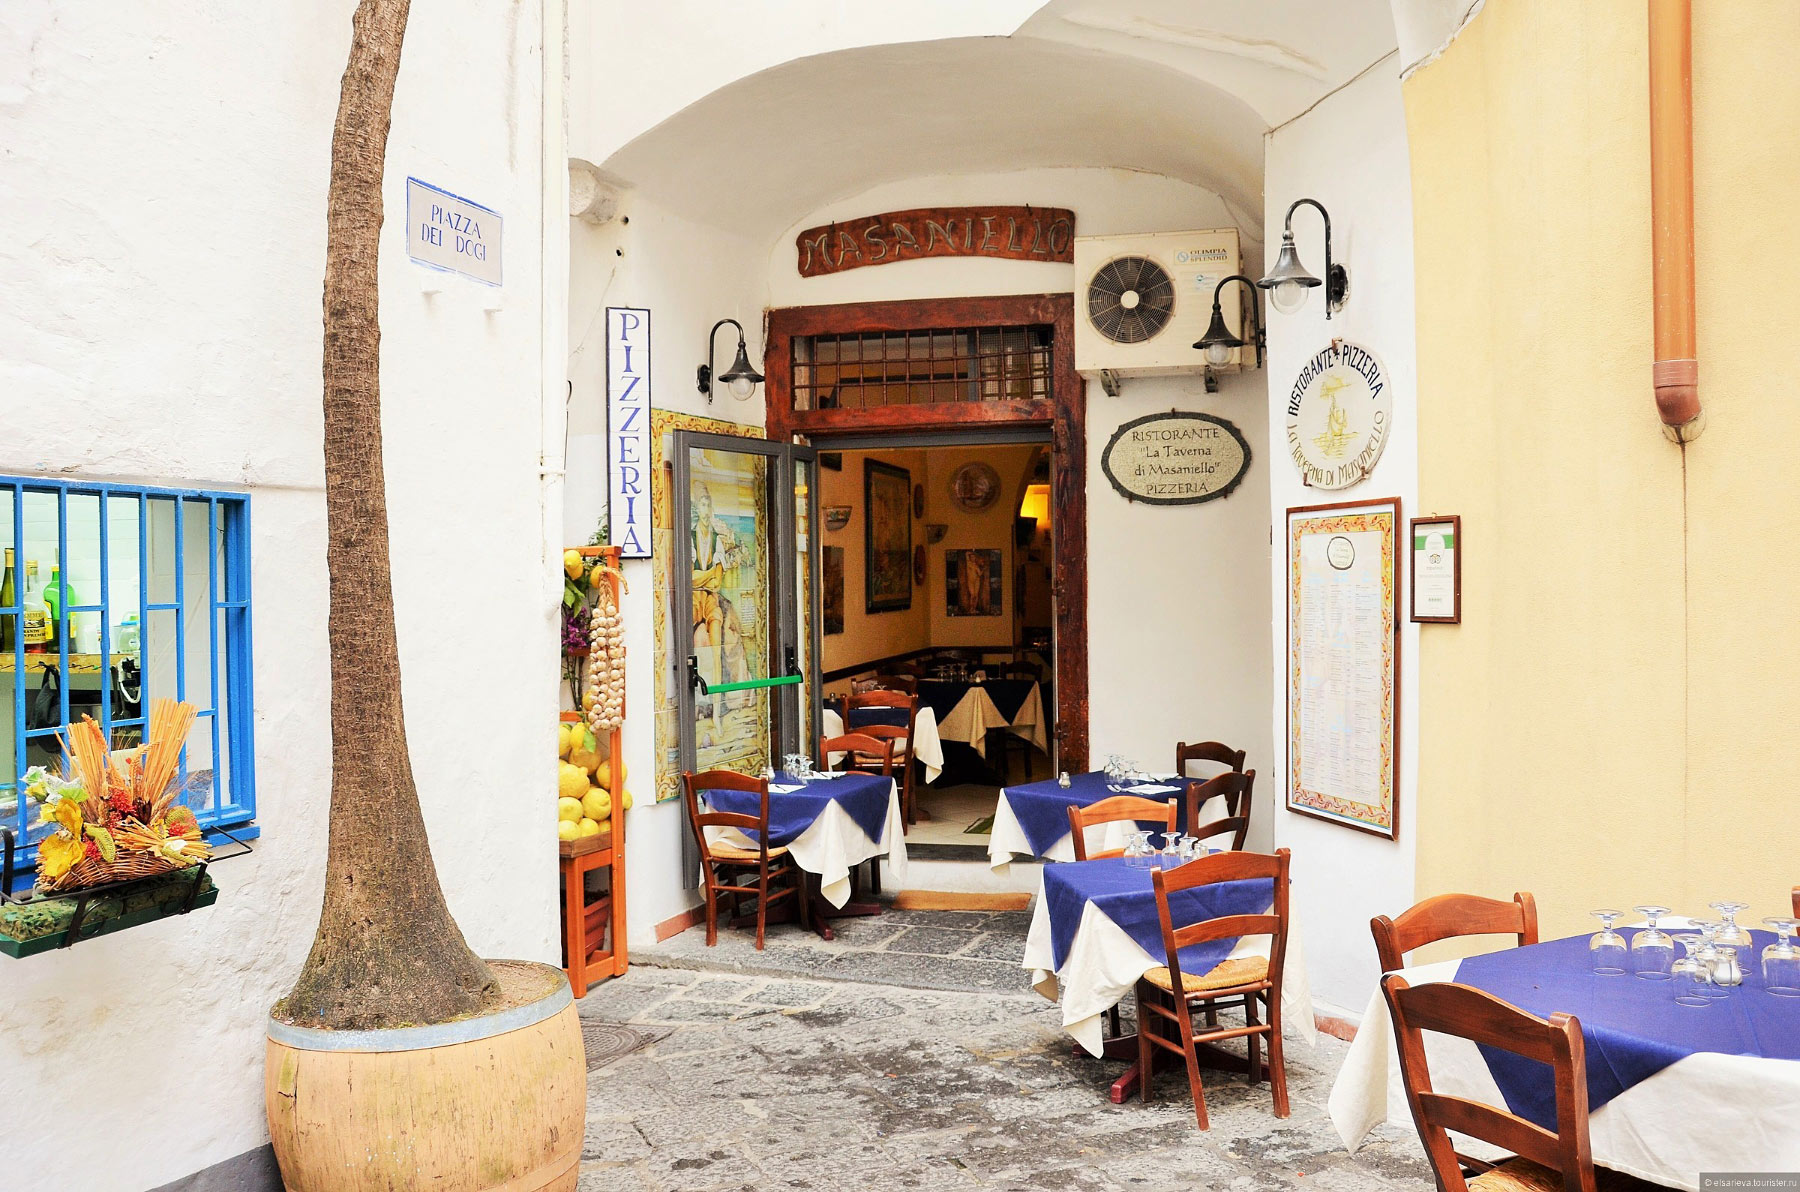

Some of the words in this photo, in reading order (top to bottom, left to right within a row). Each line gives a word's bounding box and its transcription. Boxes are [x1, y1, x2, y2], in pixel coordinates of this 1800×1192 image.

[431, 204, 481, 239] PIAZZA
[421, 223, 442, 246] DEI
[456, 235, 486, 261] DOGI
[804, 216, 1071, 271] MASANIELLO
[1288, 346, 1334, 417] RISTORANTE
[1341, 344, 1384, 400] PIZZERIA
[618, 312, 645, 554] PIZZERIA
[1132, 427, 1220, 442] RISTORANTE
[1163, 445, 1211, 458] Taverna
[1134, 464, 1146, 476] di
[1146, 482, 1209, 495] PIZZERIA
